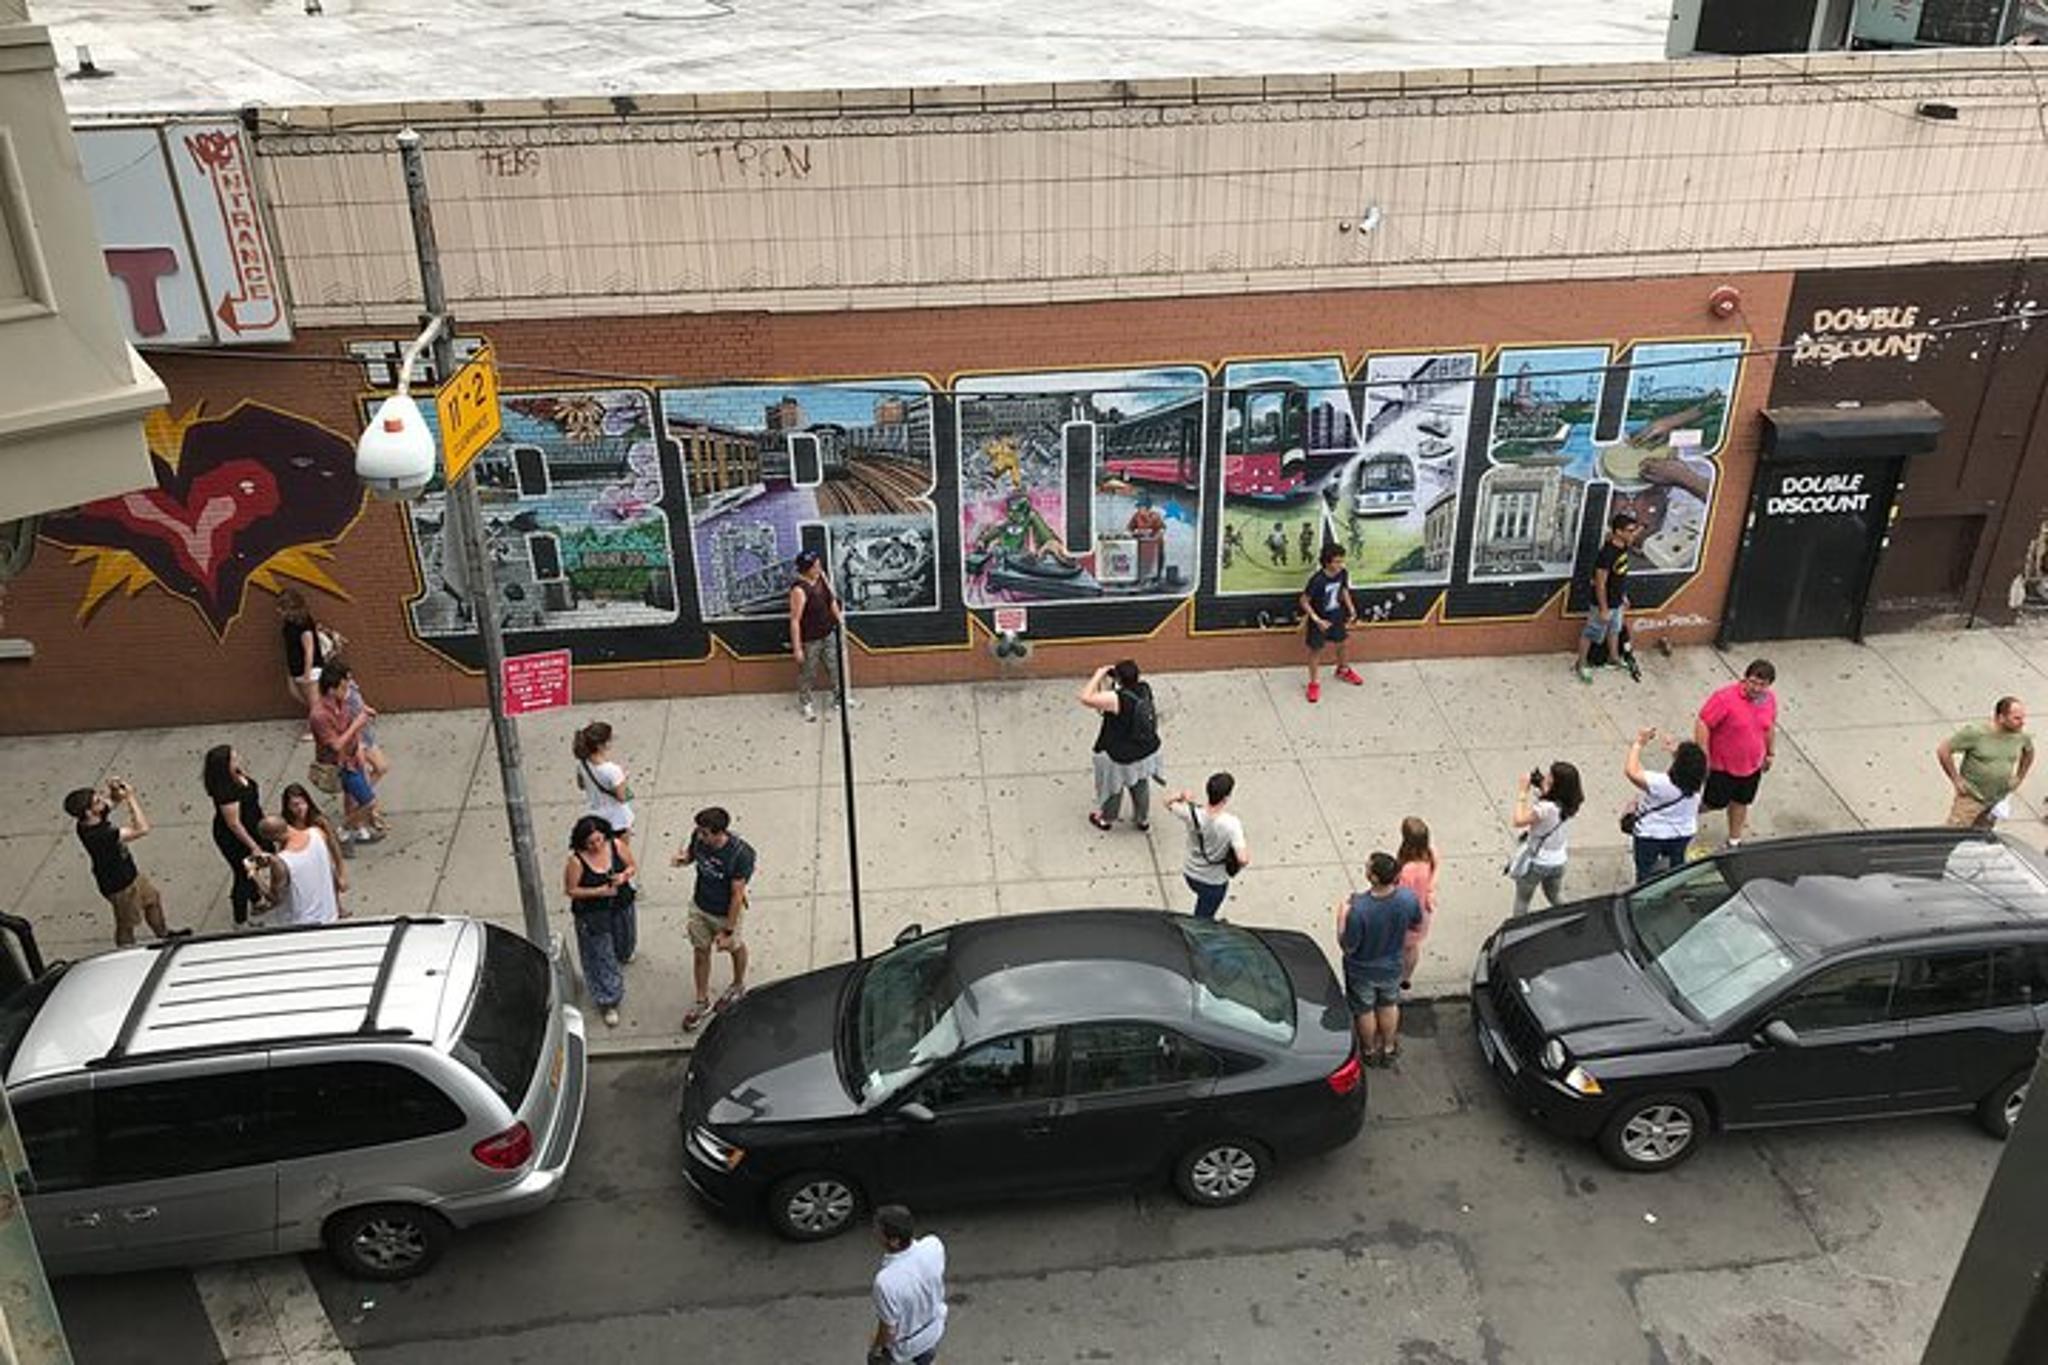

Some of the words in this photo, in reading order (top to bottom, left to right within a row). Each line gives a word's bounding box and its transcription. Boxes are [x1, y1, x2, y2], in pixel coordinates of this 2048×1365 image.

[1813, 306, 1920, 333] DOUBLE
[1794, 333, 1927, 361] DISCOUNT
[1782, 475, 1865, 495] DOUBLE
[1767, 494, 1872, 516] DISCOUNT
